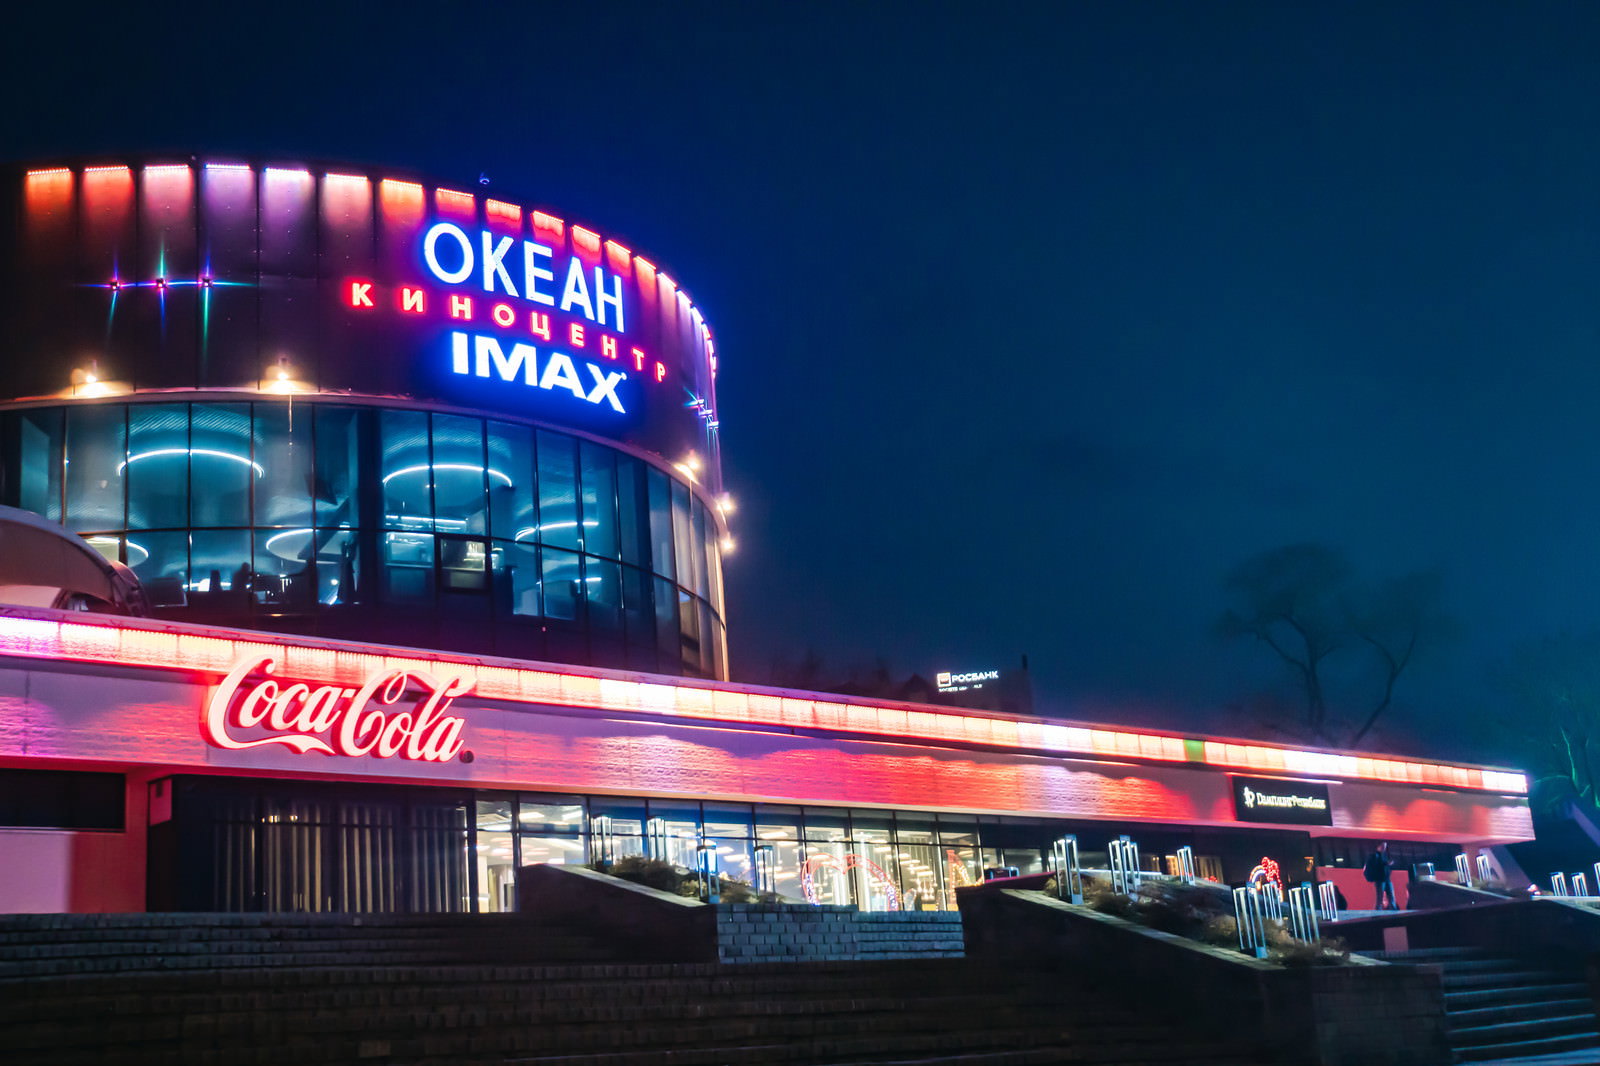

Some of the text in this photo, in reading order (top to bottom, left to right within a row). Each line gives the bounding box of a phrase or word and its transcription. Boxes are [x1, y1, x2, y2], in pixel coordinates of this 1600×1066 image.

[423, 222, 625, 333] ОКЕАН
[350, 282, 667, 382] КИНОЦЕНТР
[451, 331, 627, 414] IMAX
[204, 653, 477, 762] Coca-Cola
[951, 670, 999, 683] РОСБАНК
